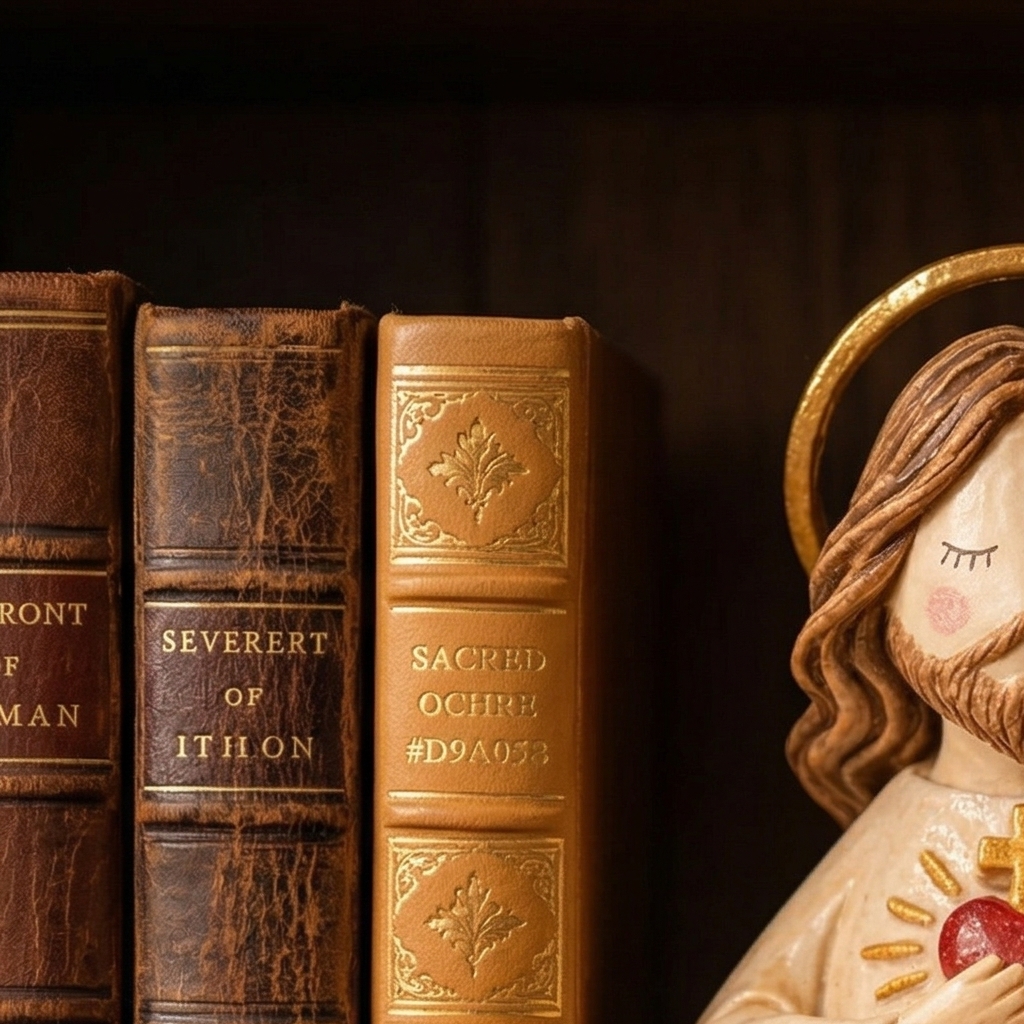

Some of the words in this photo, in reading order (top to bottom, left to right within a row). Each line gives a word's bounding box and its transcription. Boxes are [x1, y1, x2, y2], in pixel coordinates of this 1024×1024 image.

[0, 602, 87, 626] RONT
[162, 629, 328, 655] SEVERERT
[411, 645, 546, 672] SACRED
[224, 687, 264, 706] OF
[418, 691, 538, 718] OCHRE
[0, 703, 80, 728] MAN
